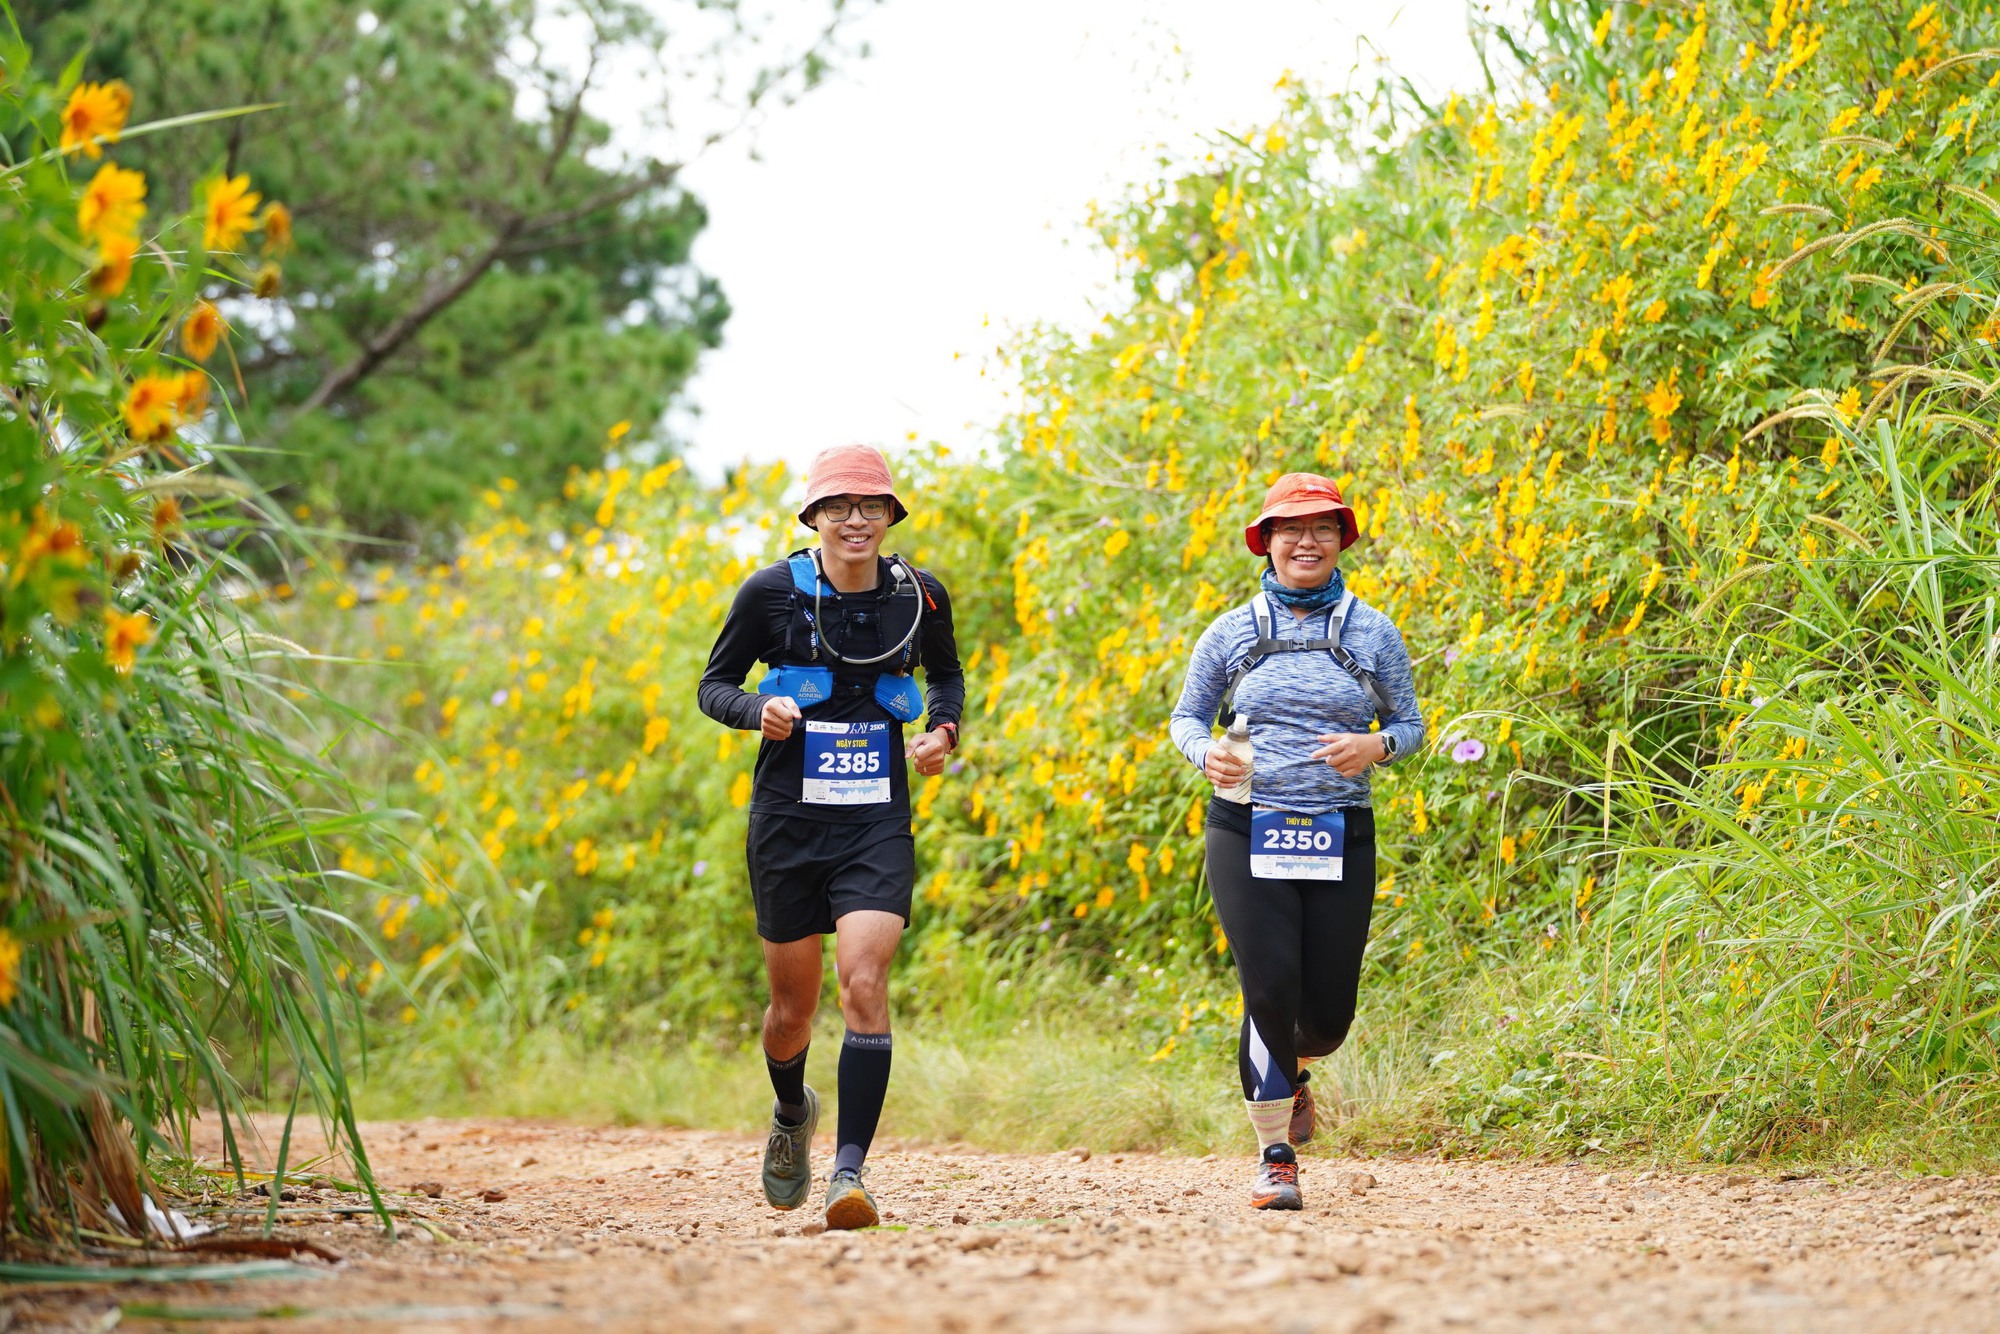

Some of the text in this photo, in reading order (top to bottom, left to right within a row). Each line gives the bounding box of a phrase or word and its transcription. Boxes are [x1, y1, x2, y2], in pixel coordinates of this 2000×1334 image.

[869, 723, 886, 731] 25KM
[852, 739, 868, 748] STORE
[818, 752, 880, 774] 2385
[1263, 829, 1332, 850] 2350
[851, 1036, 890, 1044] AONIJIE
